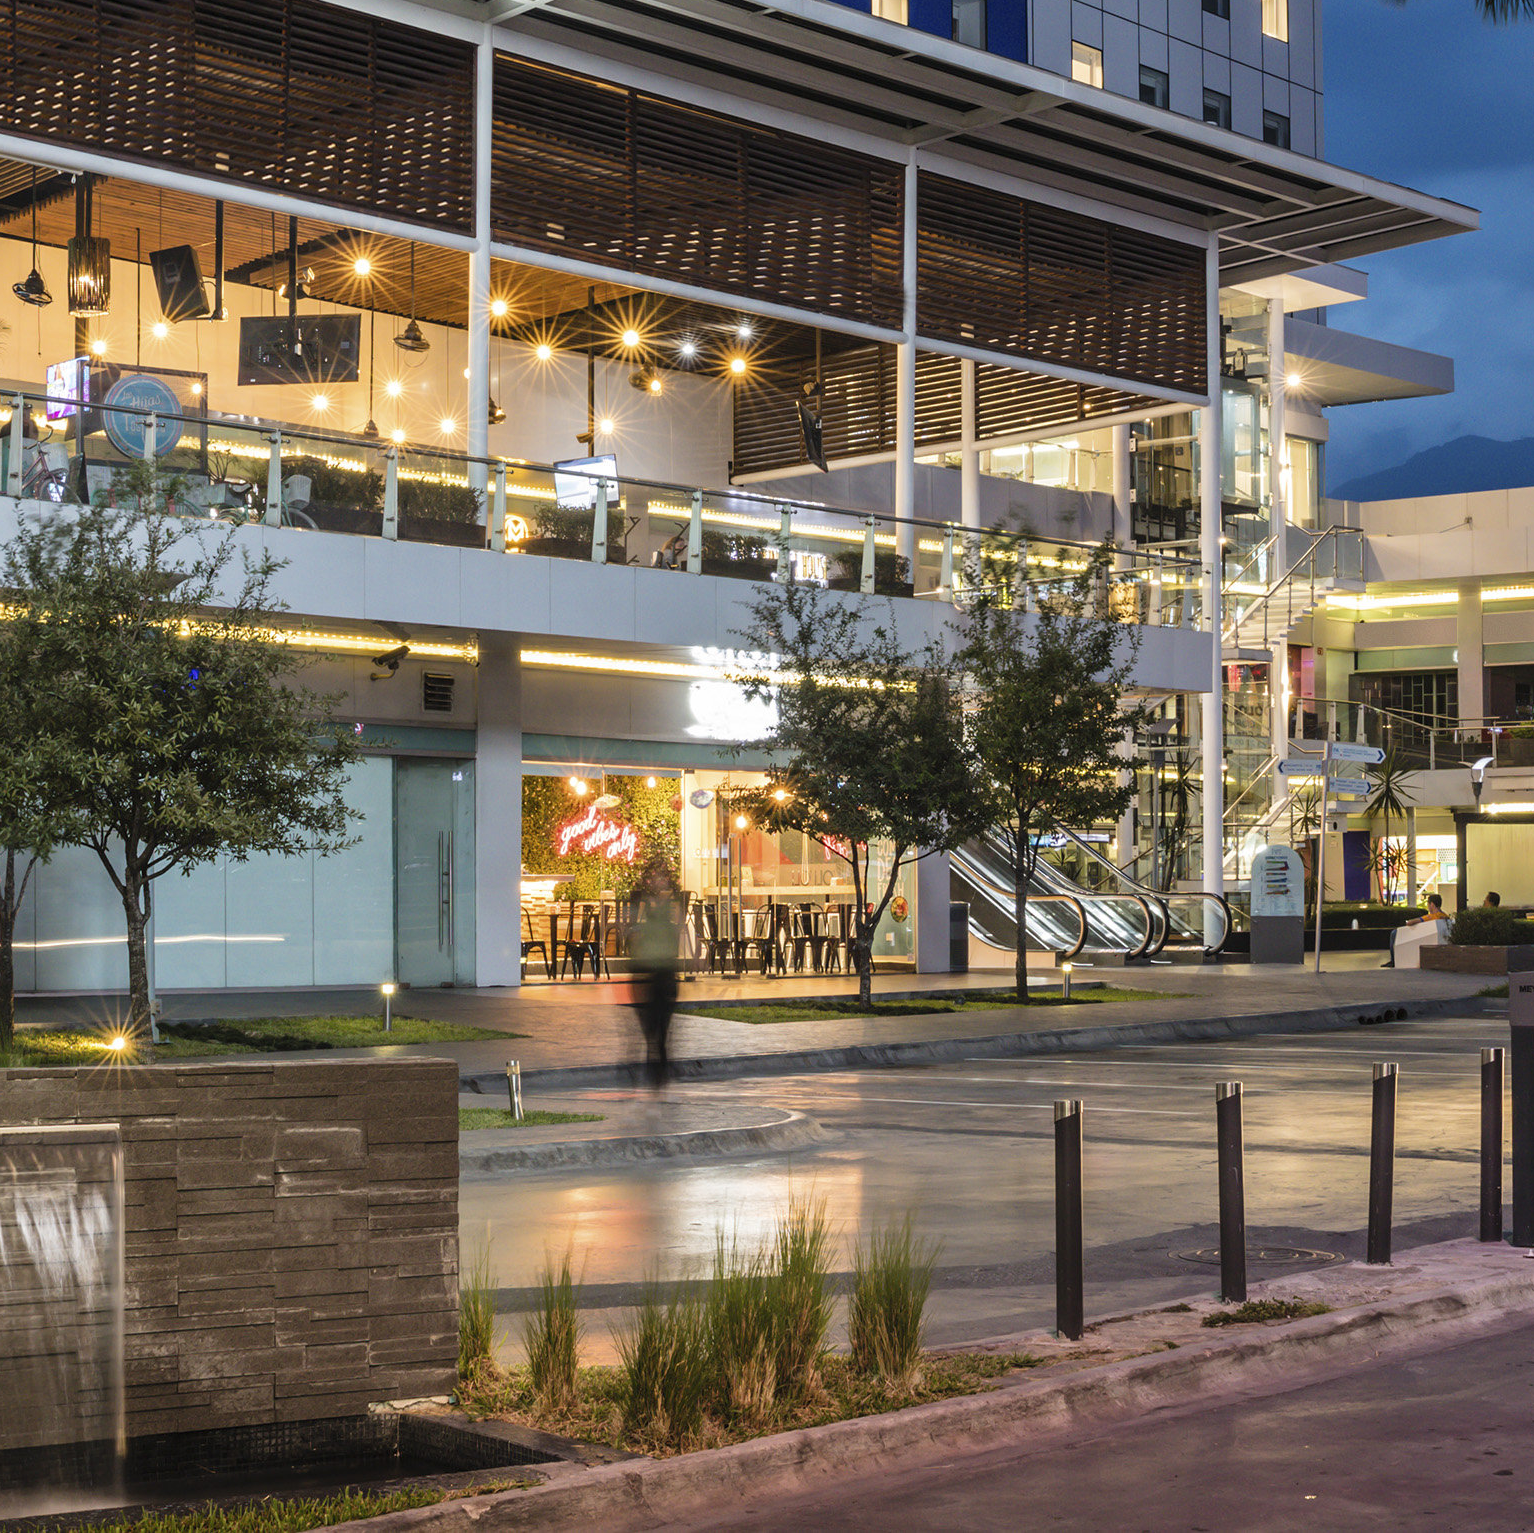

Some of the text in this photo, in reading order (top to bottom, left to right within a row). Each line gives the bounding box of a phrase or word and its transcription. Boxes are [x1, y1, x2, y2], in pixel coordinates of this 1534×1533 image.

[560, 806, 598, 855] good
[585, 821, 620, 851] vibes
[607, 826, 638, 862] only
